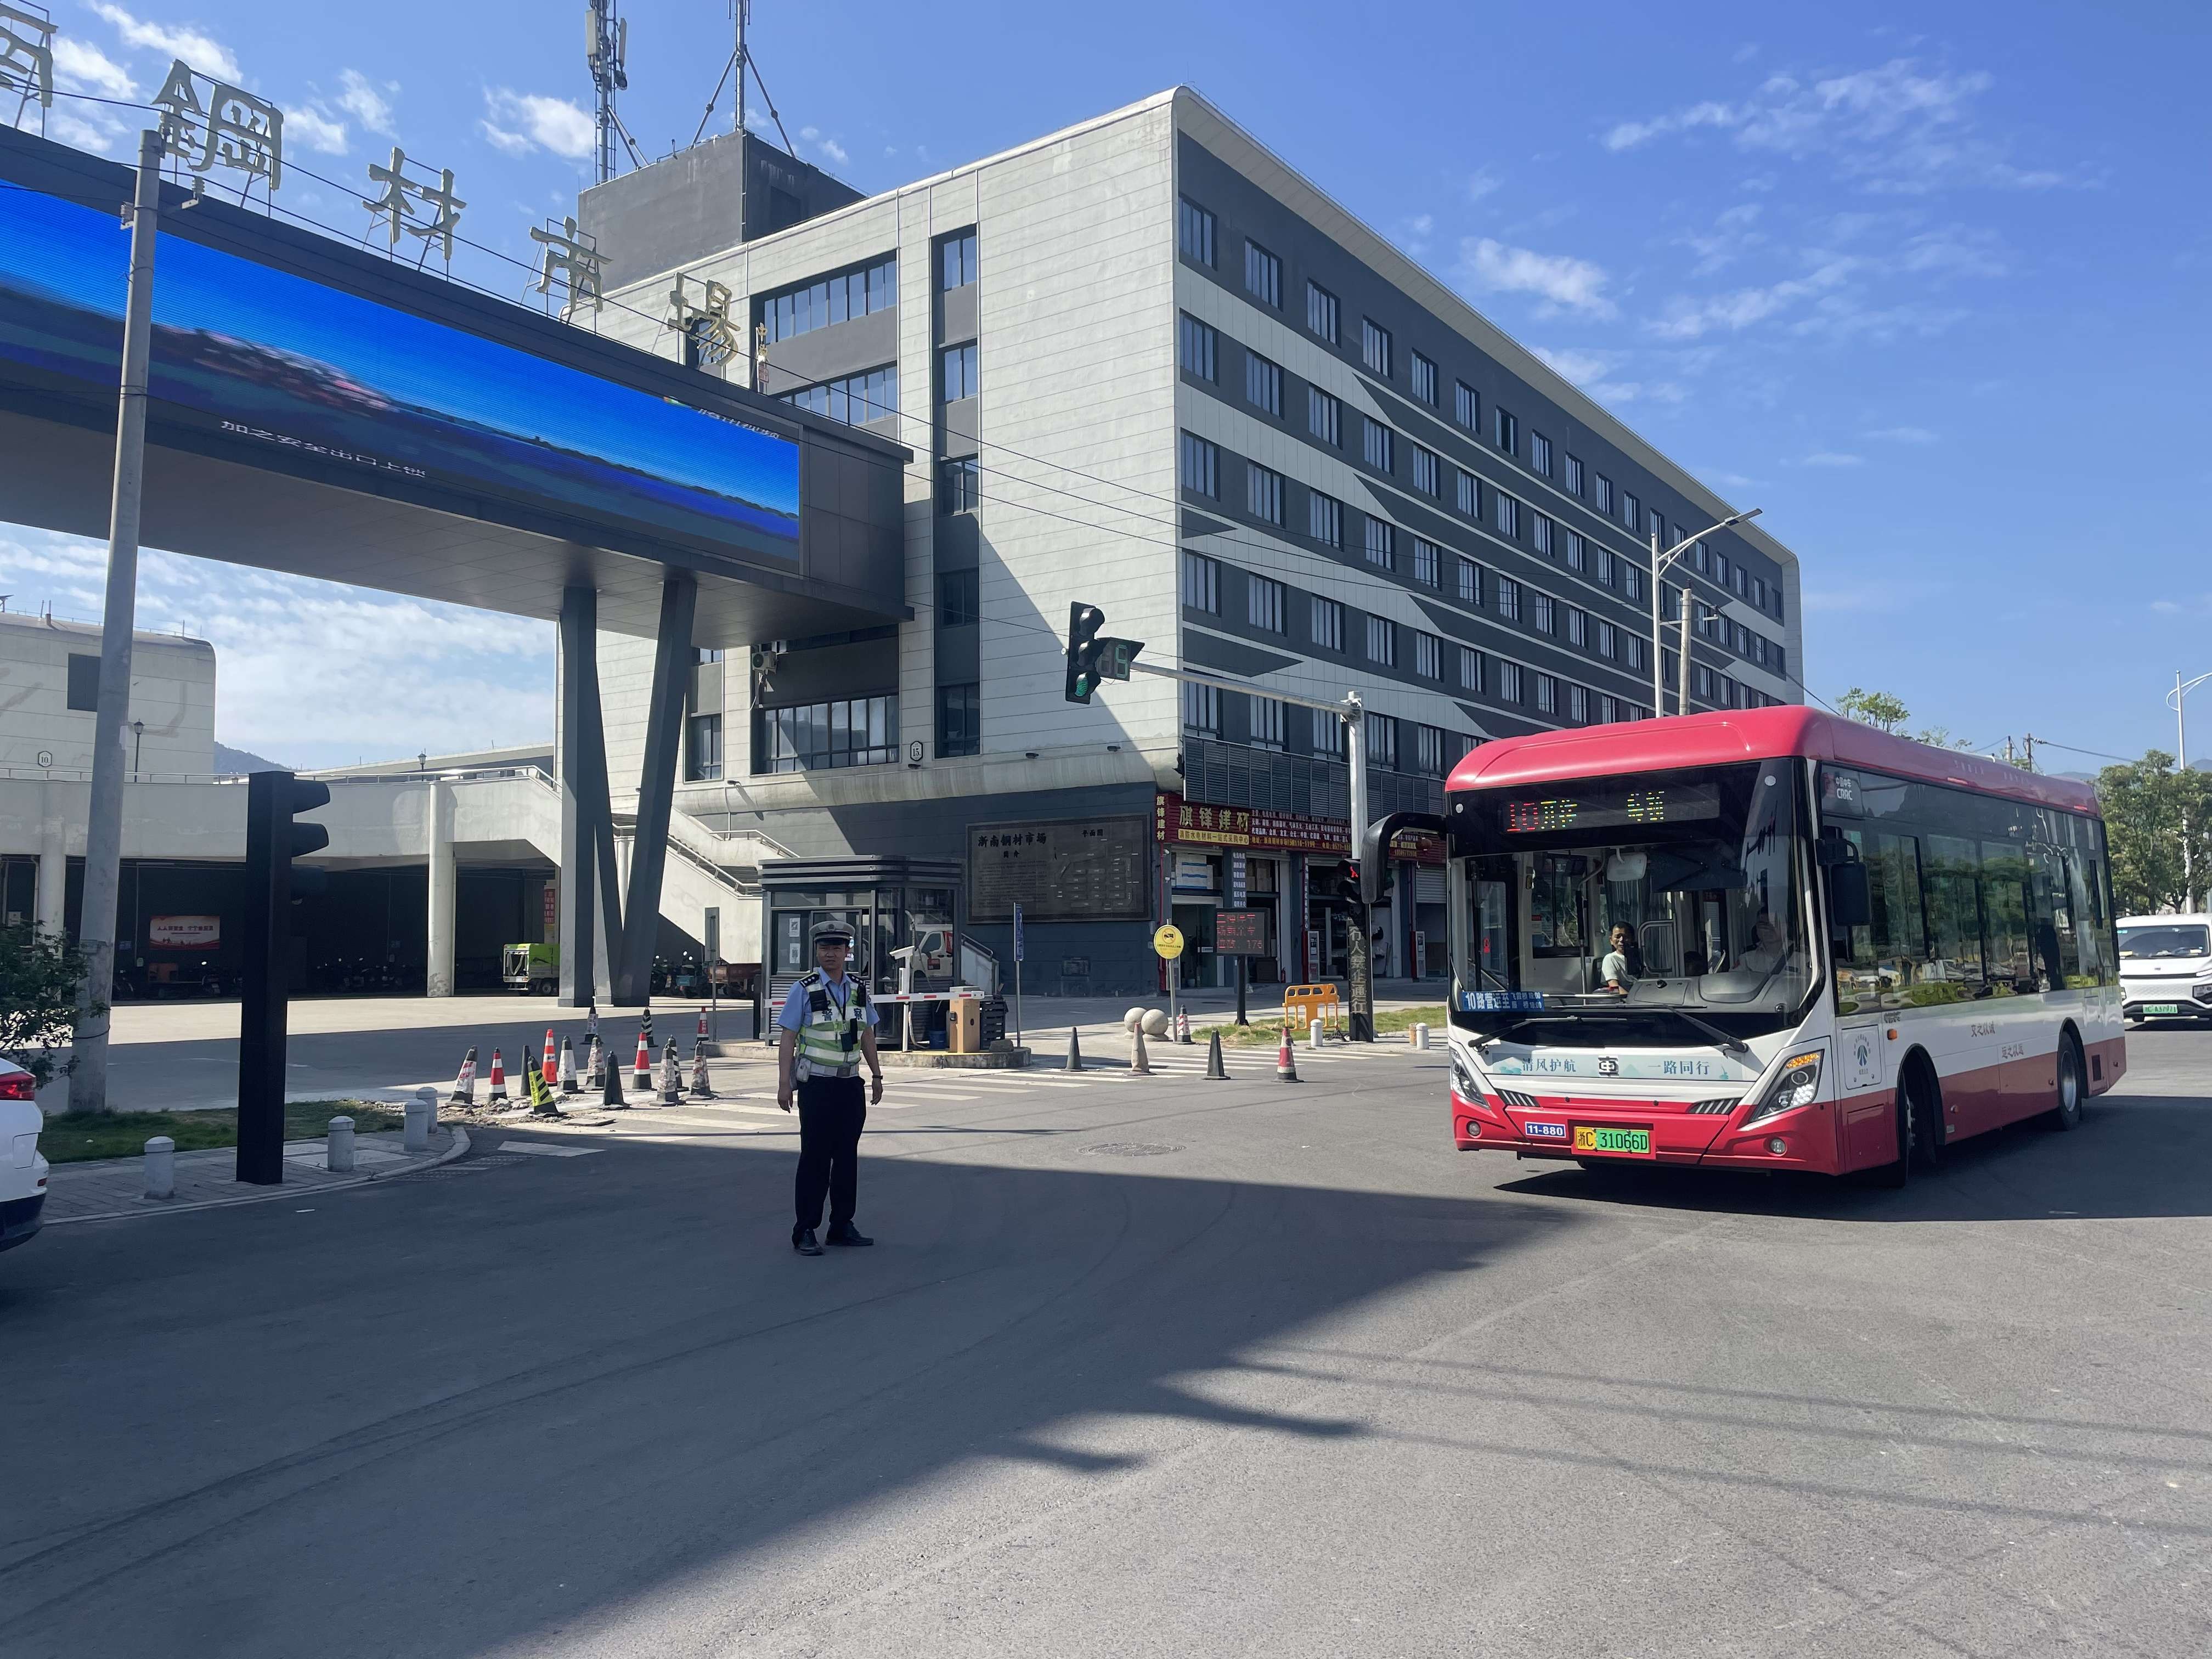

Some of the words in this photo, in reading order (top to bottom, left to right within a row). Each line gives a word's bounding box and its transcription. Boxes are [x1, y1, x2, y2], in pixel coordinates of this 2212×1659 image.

[1837, 788, 1853, 800] CRRC
[1465, 992, 1510, 1009] 10路营运至
[1522, 1058, 1576, 1072] 清风护航
[1647, 1060, 1710, 1075] 一路同行
[1527, 1125, 1563, 1136] 11-880
[1577, 1131, 1593, 1147] 浙C
[1600, 1132, 1647, 1150] 31066D
